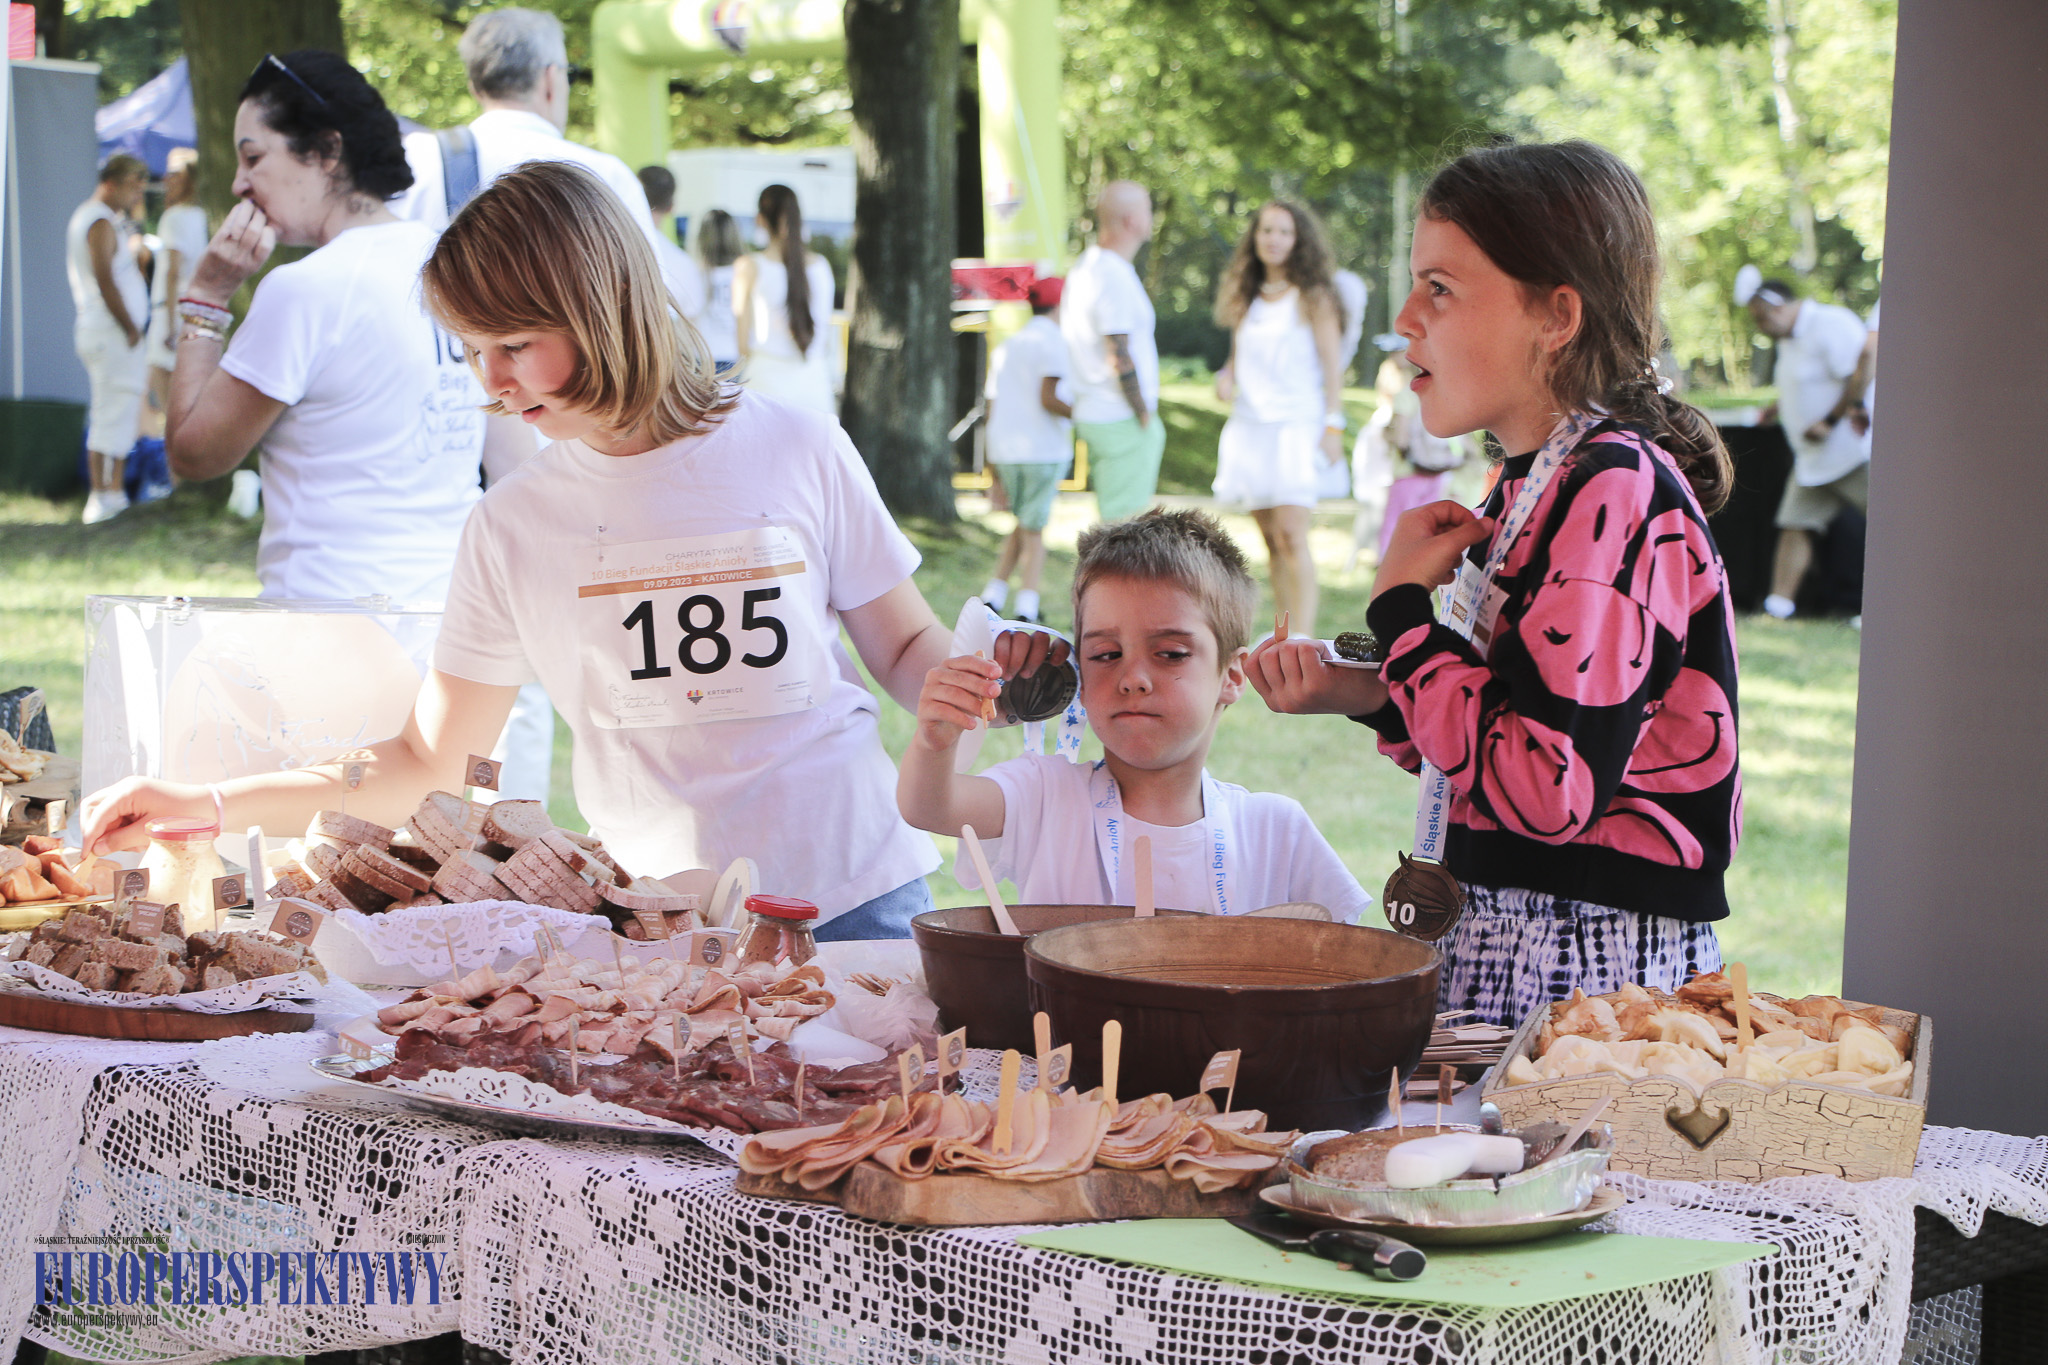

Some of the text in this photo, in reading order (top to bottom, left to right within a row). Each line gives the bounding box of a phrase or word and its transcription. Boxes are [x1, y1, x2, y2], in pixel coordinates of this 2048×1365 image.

[665, 545, 744, 561] CHARYTATYWNY
[591, 571, 604, 581] 10
[605, 567, 628, 579] Bieg
[629, 562, 673, 577] Fundacji
[674, 558, 711, 573] Śląskie
[643, 577, 692, 589] 09.09.2023
[701, 570, 753, 583] KATOWICE
[622, 586, 788, 680] 185
[1214, 828, 1225, 840] 10
[1420, 801, 1442, 853] Śląskie
[1212, 843, 1226, 869] Bieg
[1386, 900, 1416, 925] 10
